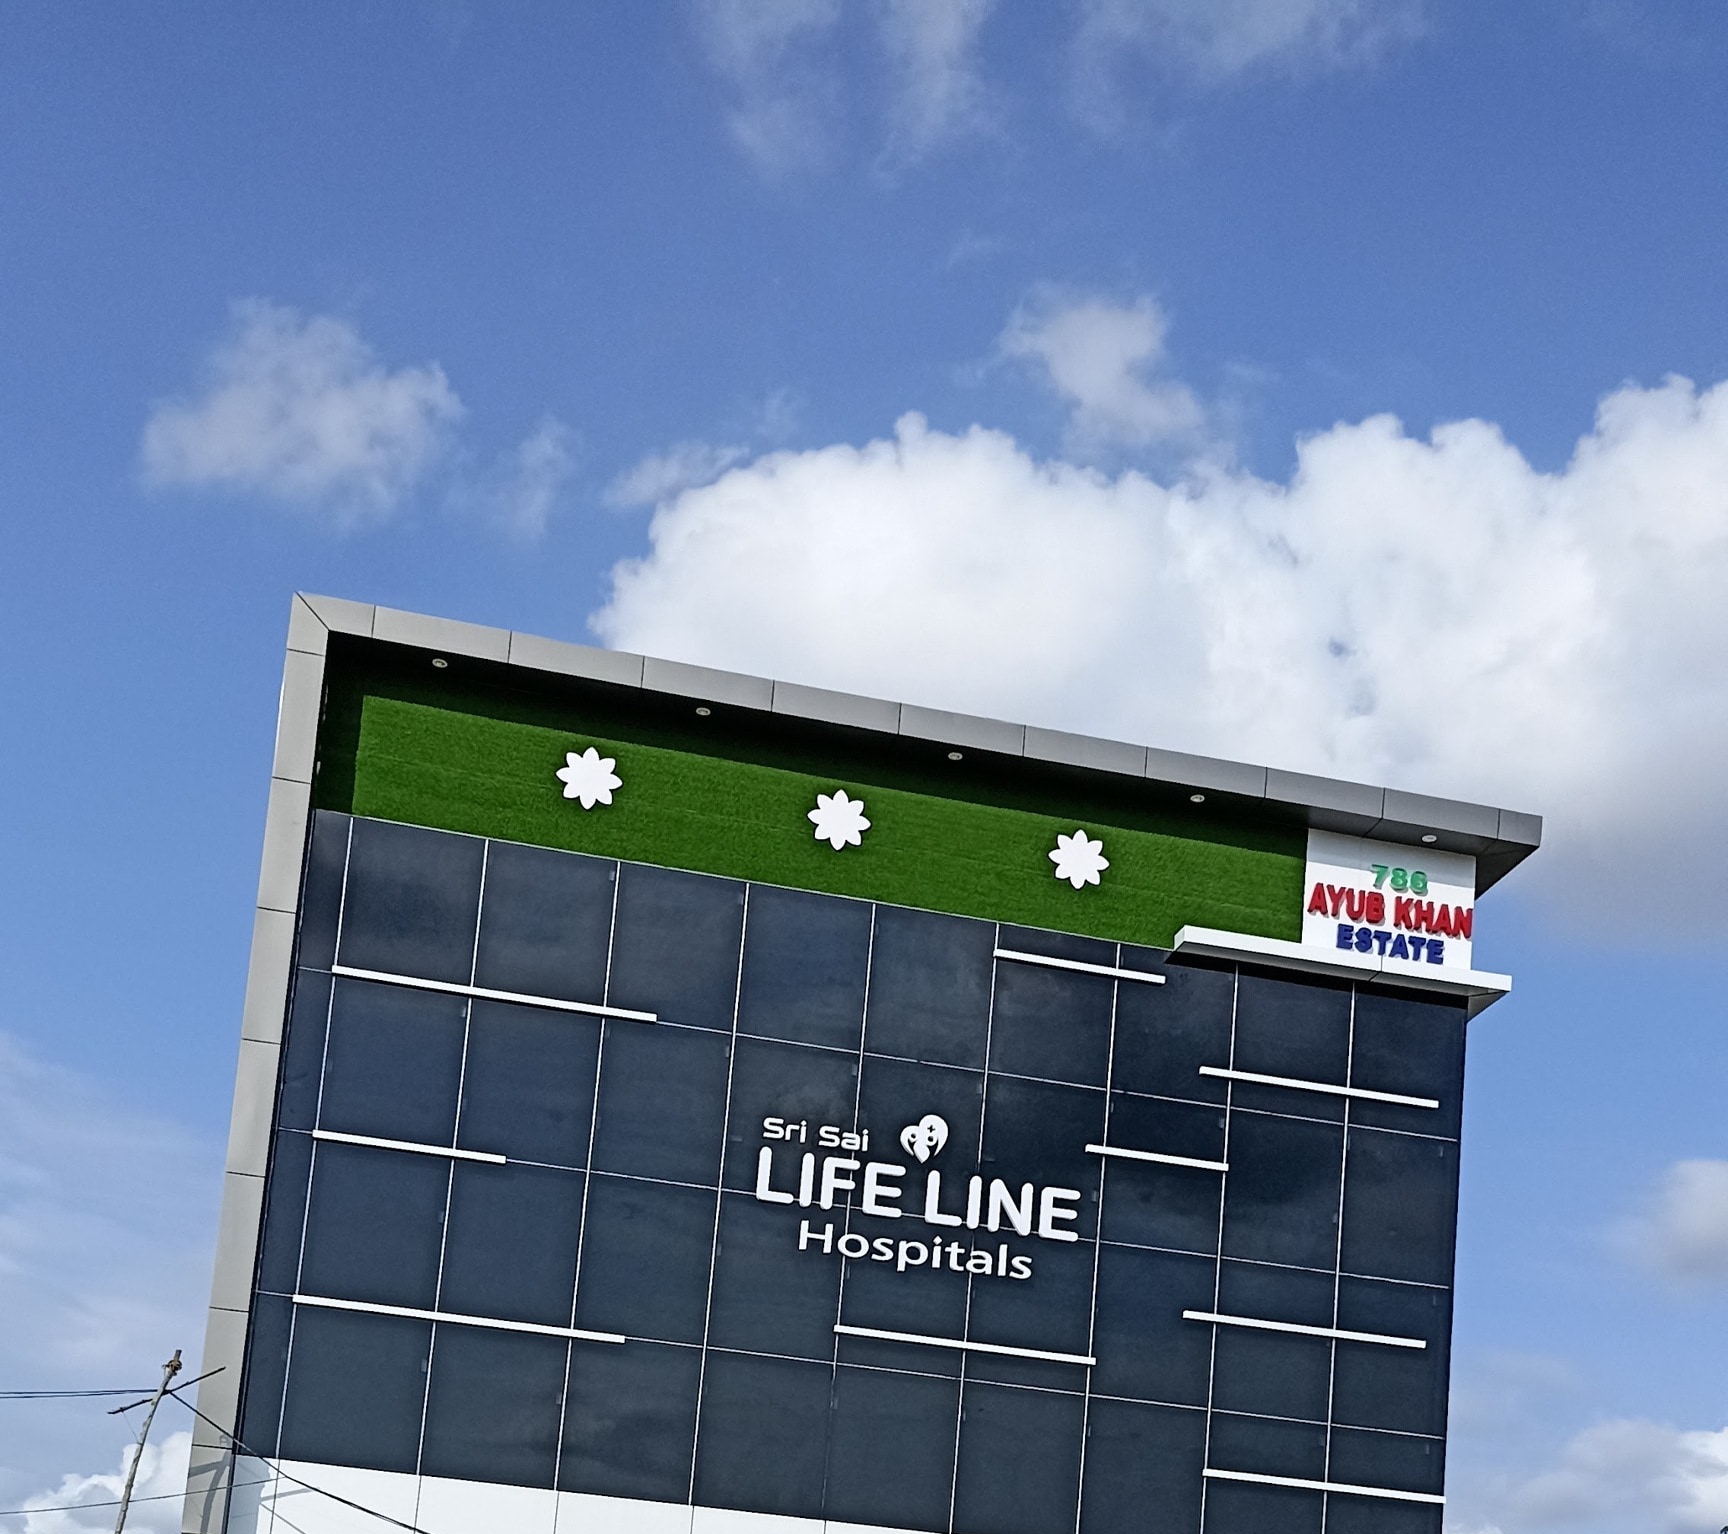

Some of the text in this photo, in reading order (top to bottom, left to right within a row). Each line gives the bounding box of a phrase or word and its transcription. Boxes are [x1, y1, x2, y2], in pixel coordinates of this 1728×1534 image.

[1371, 864, 1428, 895] 786
[1307, 882, 1473, 940] AYUB KHAN
[1336, 923, 1444, 965] ESTATE
[762, 1116, 869, 1151] Sri Sai
[756, 1146, 1081, 1243] LIFE LINE
[798, 1220, 1033, 1279] Hospitals
